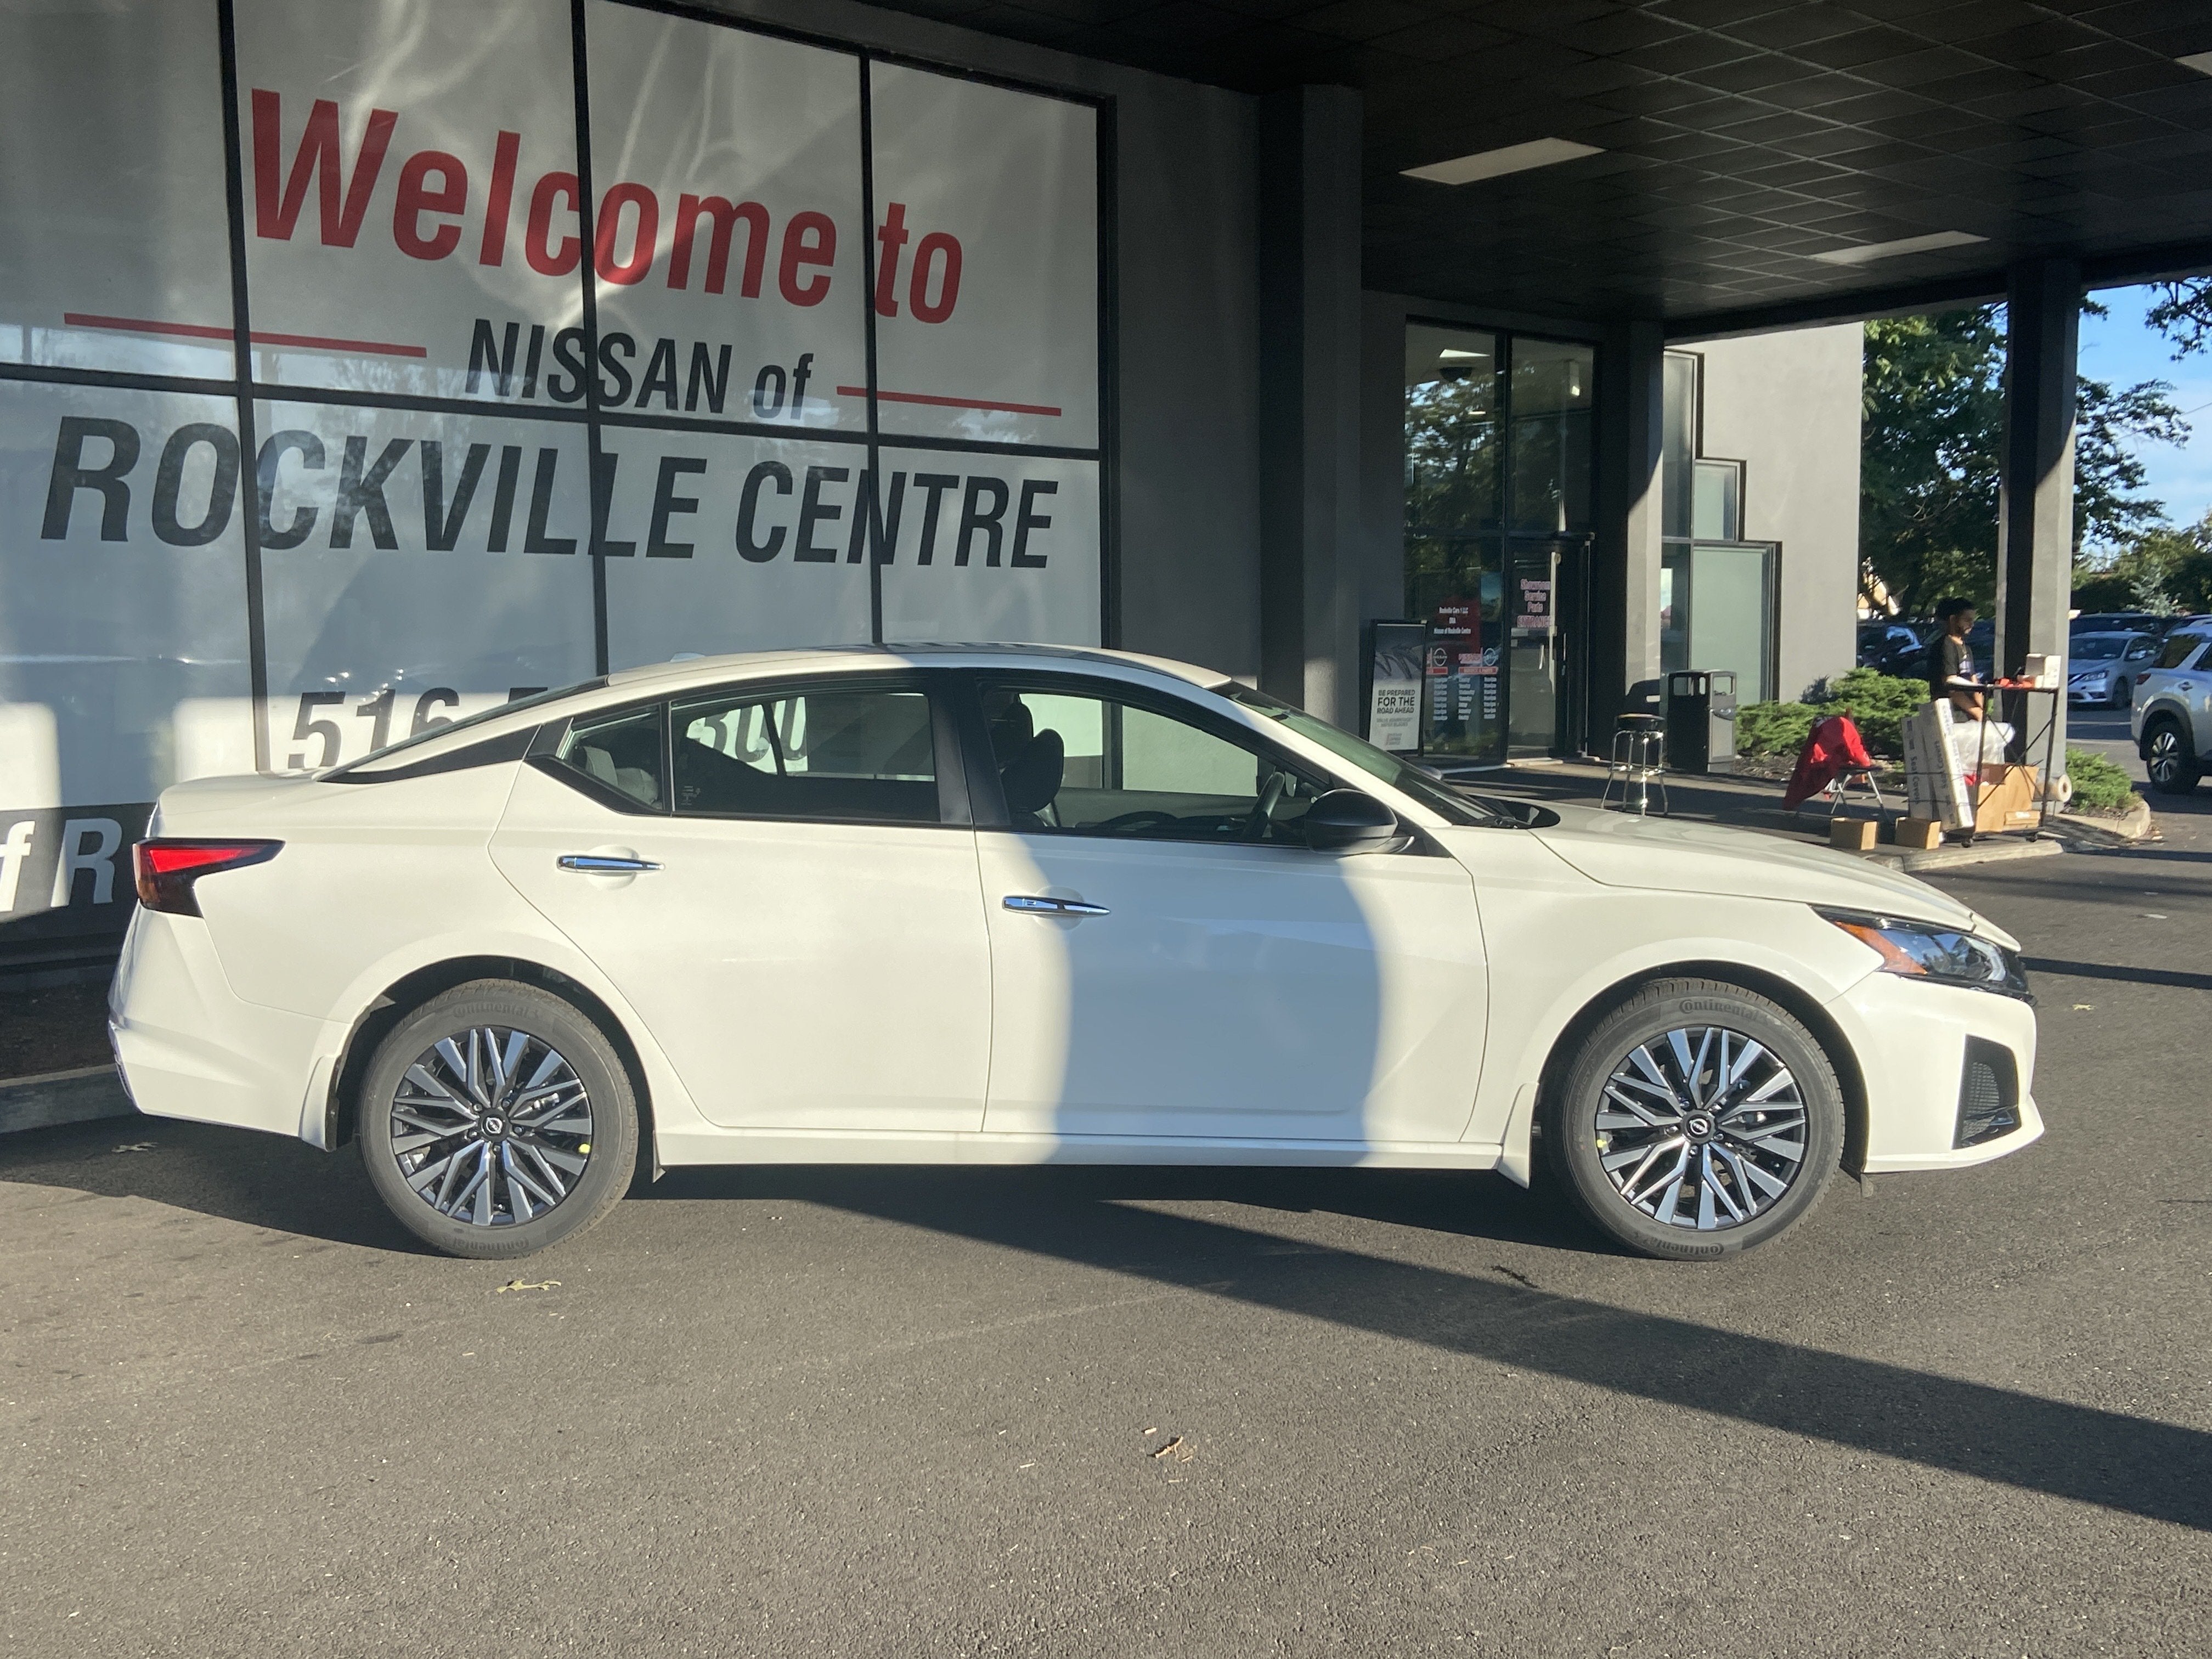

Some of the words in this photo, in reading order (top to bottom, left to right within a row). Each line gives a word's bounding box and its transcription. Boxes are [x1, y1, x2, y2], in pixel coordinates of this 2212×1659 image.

[252, 88, 837, 307] Welcome
[873, 201, 963, 324] to
[464, 318, 732, 414] NISSAN
[752, 352, 814, 421] of
[41, 416, 708, 560] ROCKVILLE
[735, 460, 1059, 569] CENTRE
[1520, 579, 1551, 590] Showroom
[1525, 590, 1547, 601] Service
[1527, 601, 1543, 612] Parts
[1378, 697, 1396, 707] FOR
[1398, 697, 1415, 706] THE
[288, 687, 460, 769] 516
[1679, 999, 1759, 1021] Continental
